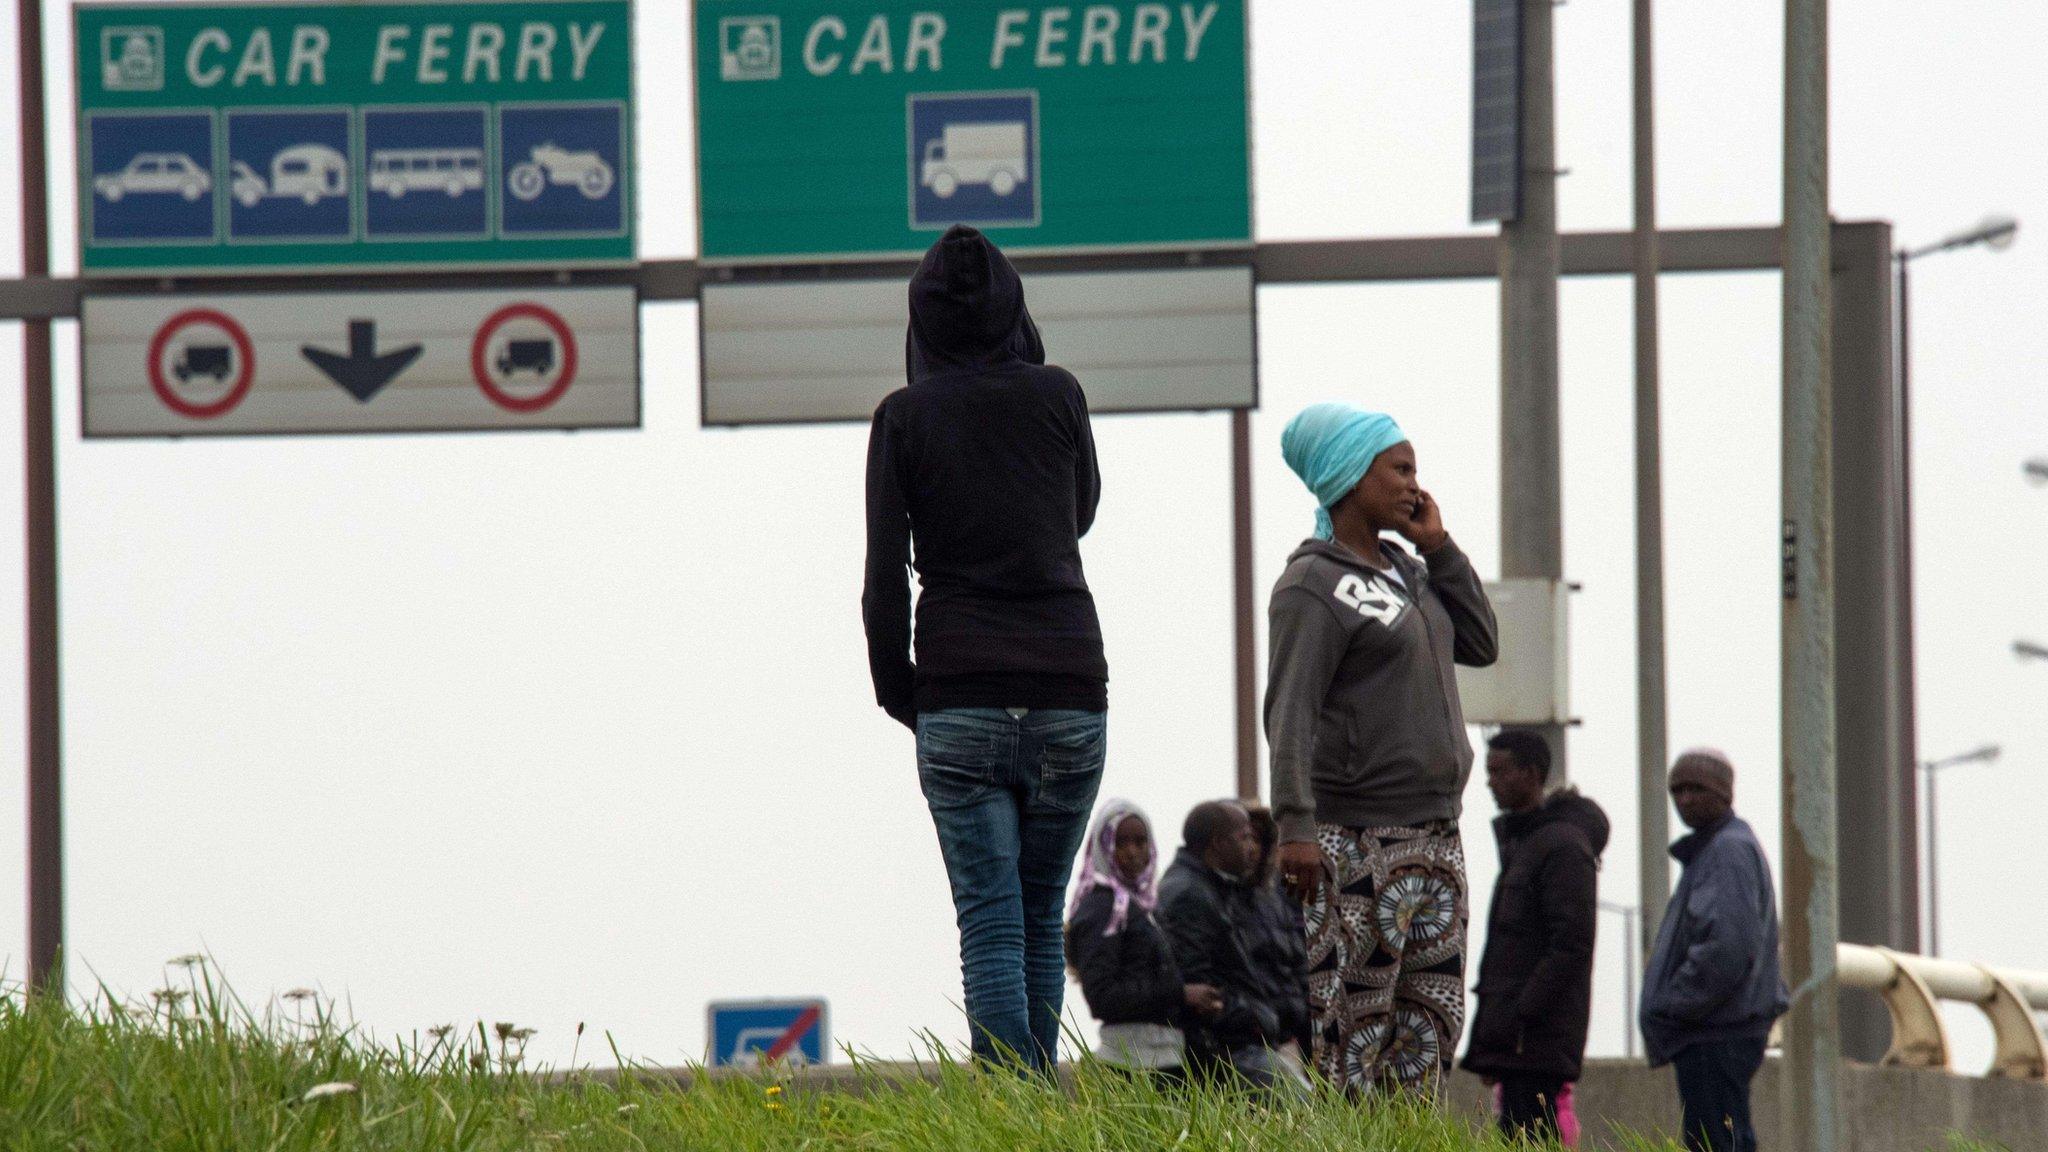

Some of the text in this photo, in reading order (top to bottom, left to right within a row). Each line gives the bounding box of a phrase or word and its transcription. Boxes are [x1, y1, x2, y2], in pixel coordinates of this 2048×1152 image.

[185, 22, 606, 87] CAR FERRY
[802, 3, 1220, 75] CAR FERRY
